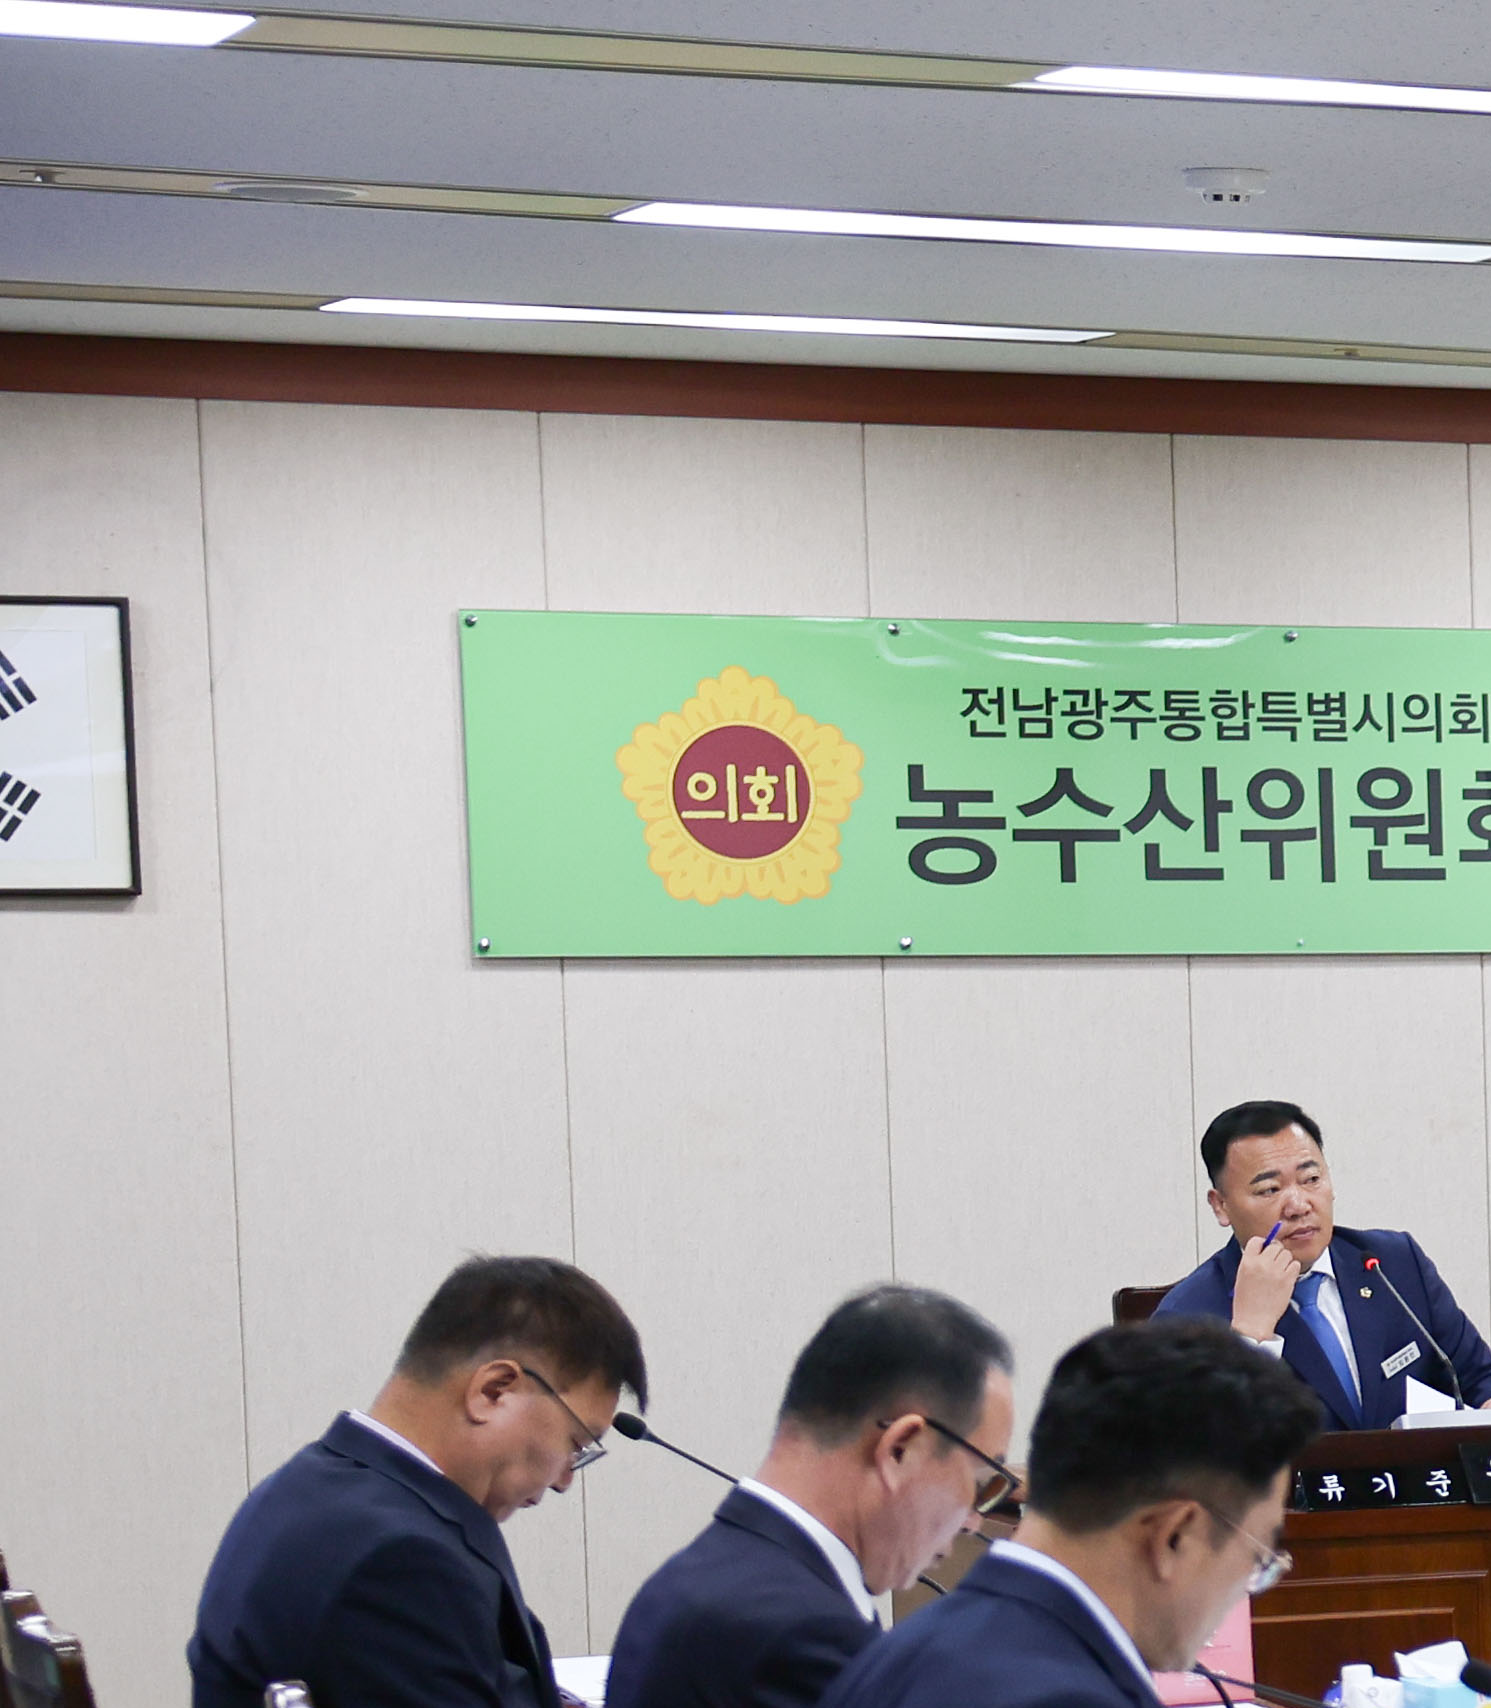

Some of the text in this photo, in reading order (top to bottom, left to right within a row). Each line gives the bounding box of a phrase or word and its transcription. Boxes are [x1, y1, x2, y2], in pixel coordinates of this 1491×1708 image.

[959, 685, 1491, 746] 전남광주통합특별시의회
[681, 763, 799, 826] 의회
[1318, 1469, 1453, 1503] 류기준
